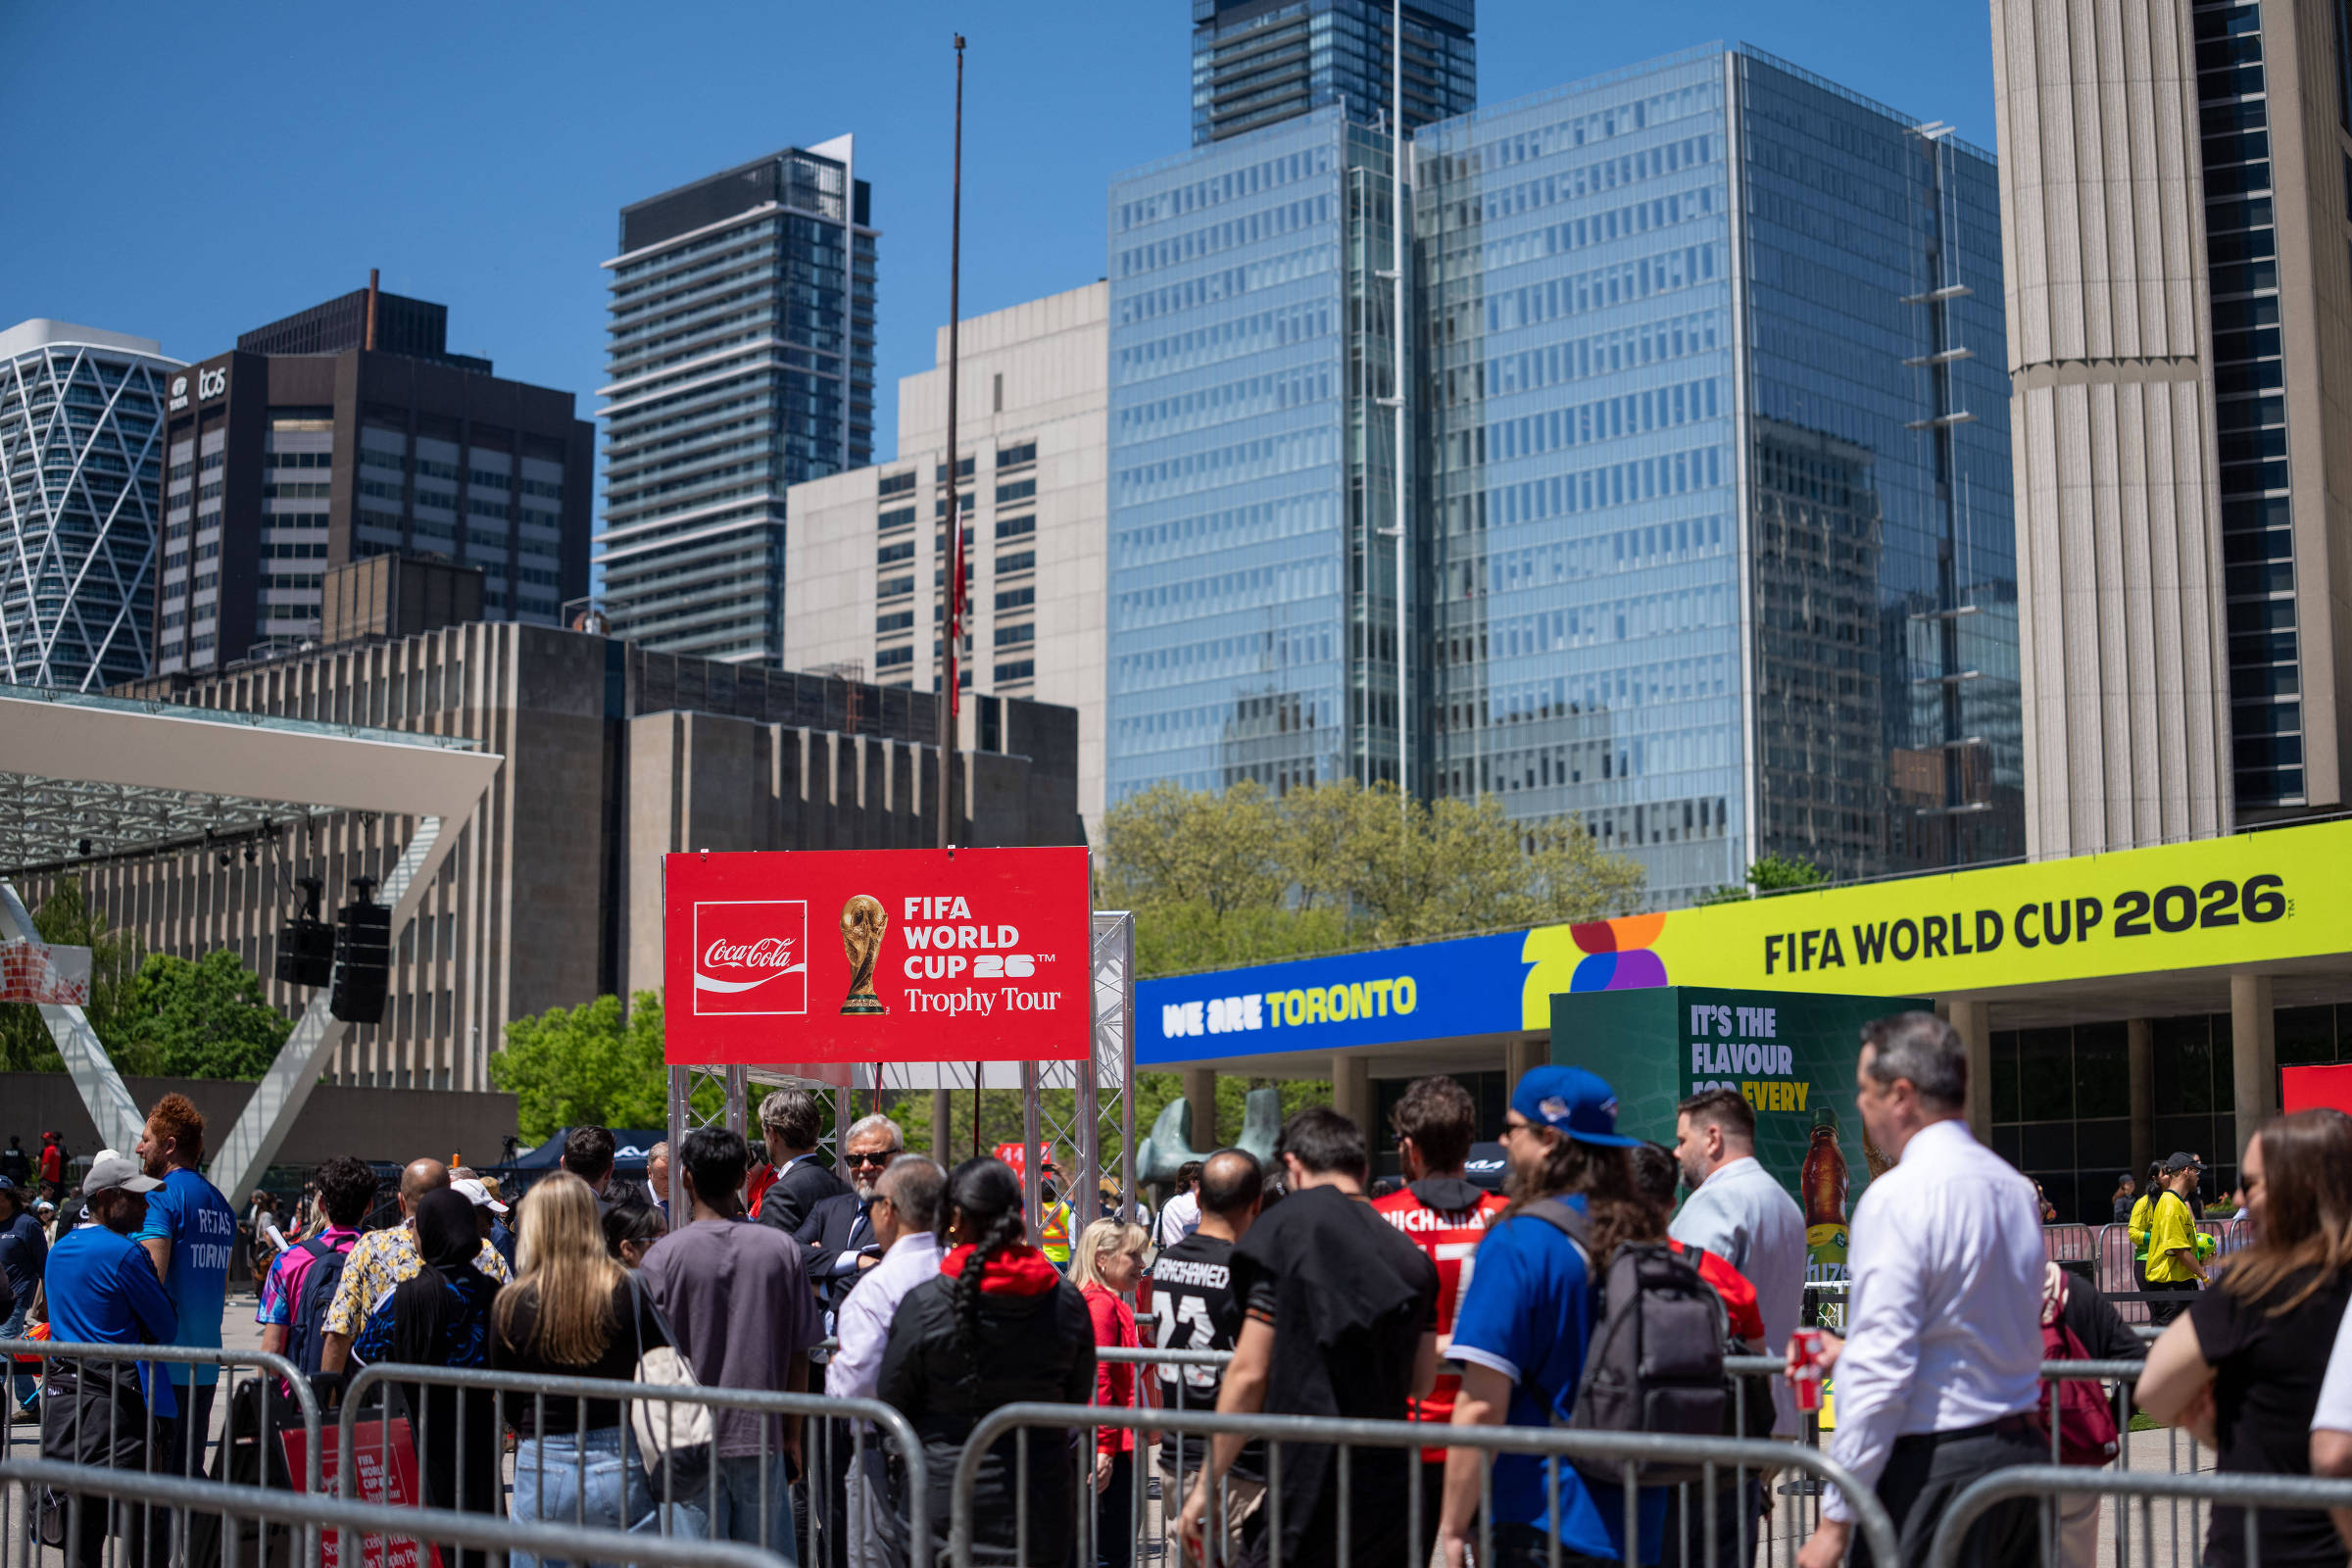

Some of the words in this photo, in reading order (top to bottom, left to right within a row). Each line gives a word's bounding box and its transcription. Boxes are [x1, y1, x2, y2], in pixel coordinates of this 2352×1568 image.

[905, 896, 972, 919] FIFA
[903, 925, 1019, 950] WORLD
[1765, 928, 1845, 975] FIFA
[1852, 909, 2003, 964] WORLD
[2014, 897, 2103, 948] CUP
[2113, 874, 2285, 938] 2026
[705, 938, 796, 968] Coca-Cola
[904, 956, 967, 979] CUP
[973, 954, 1035, 978] 26
[904, 987, 997, 1017] Trophy
[1001, 987, 1061, 1010] Tour
[1162, 1002, 1204, 1039] WE
[1206, 994, 1262, 1034] ARE
[1265, 976, 1417, 1028] TORONTO
[1690, 1004, 1733, 1037] IT'S
[1736, 1006, 1777, 1038] THE
[1691, 1043, 1793, 1075] FLAVOUR
[1741, 1081, 1810, 1111] EVERY
[361, 1466, 385, 1478] WORL
